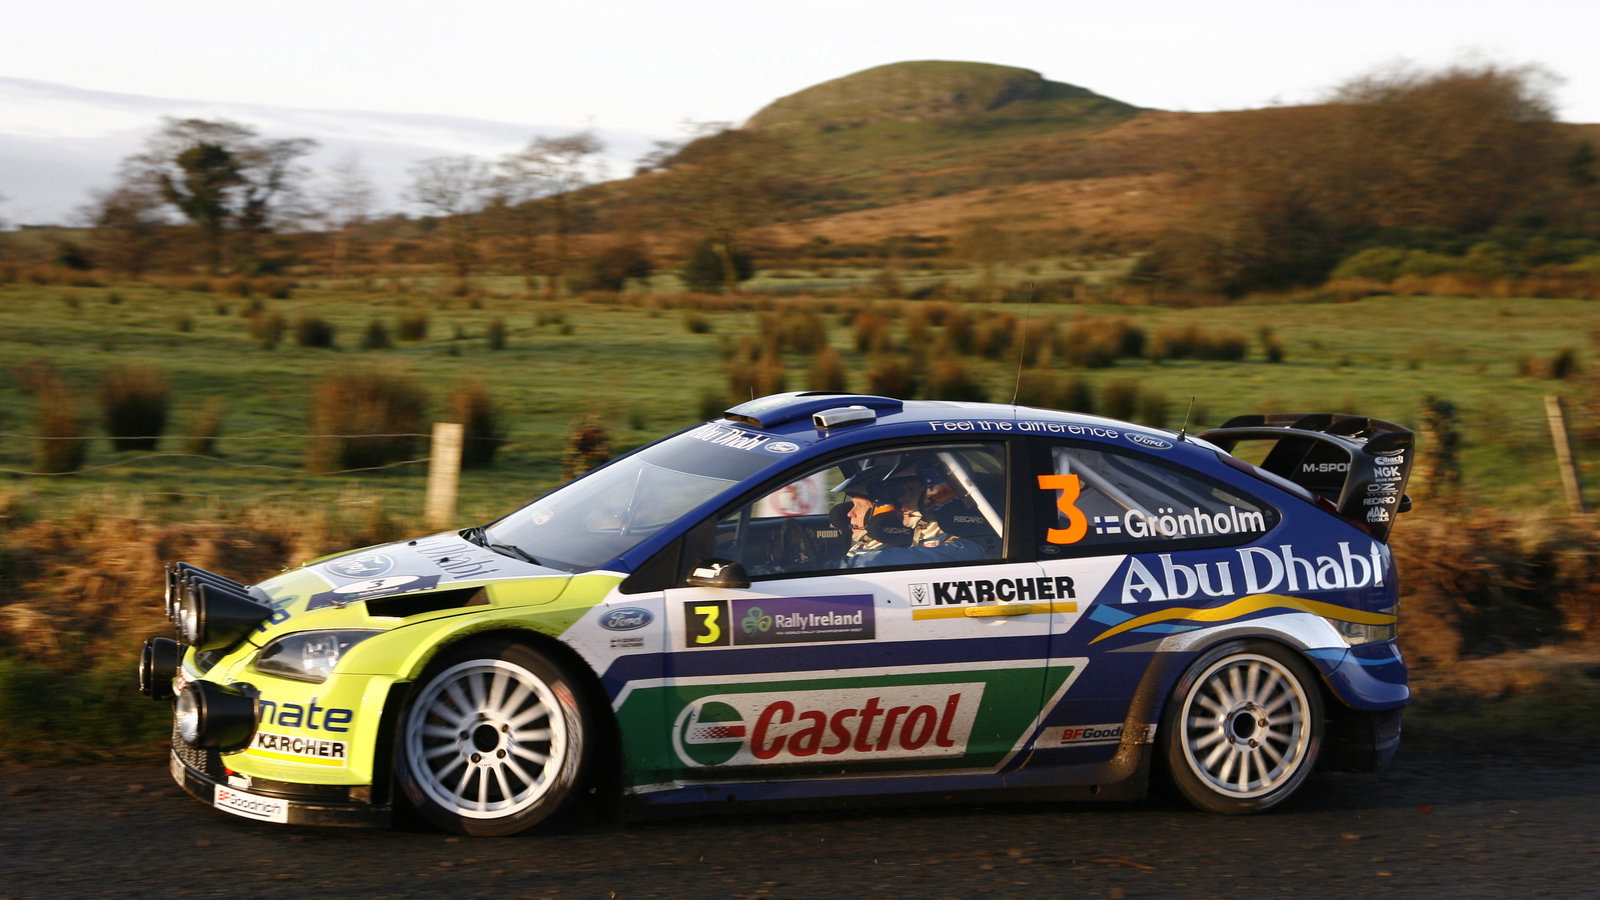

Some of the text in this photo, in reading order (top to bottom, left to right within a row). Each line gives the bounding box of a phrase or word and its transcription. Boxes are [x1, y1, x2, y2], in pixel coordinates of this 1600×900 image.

[929, 420, 1118, 439] Feel the difference
[1132, 432, 1166, 447] Ford
[1374, 466, 1401, 478] NGK
[1037, 474, 1088, 545] 3
[1363, 496, 1396, 506] RECARO
[1124, 505, 1266, 538] Grönholm
[816, 530, 839, 539] PUMA
[1121, 541, 1385, 605] Abu Dhabi
[932, 576, 1077, 606] KÄRCHER
[607, 611, 647, 628] Ford
[694, 605, 721, 644] 3
[775, 610, 863, 630] Rally Ireland
[749, 692, 962, 760] Castrol
[257, 733, 345, 758] KÄRCHER
[218, 789, 282, 815] BFGoodrich
